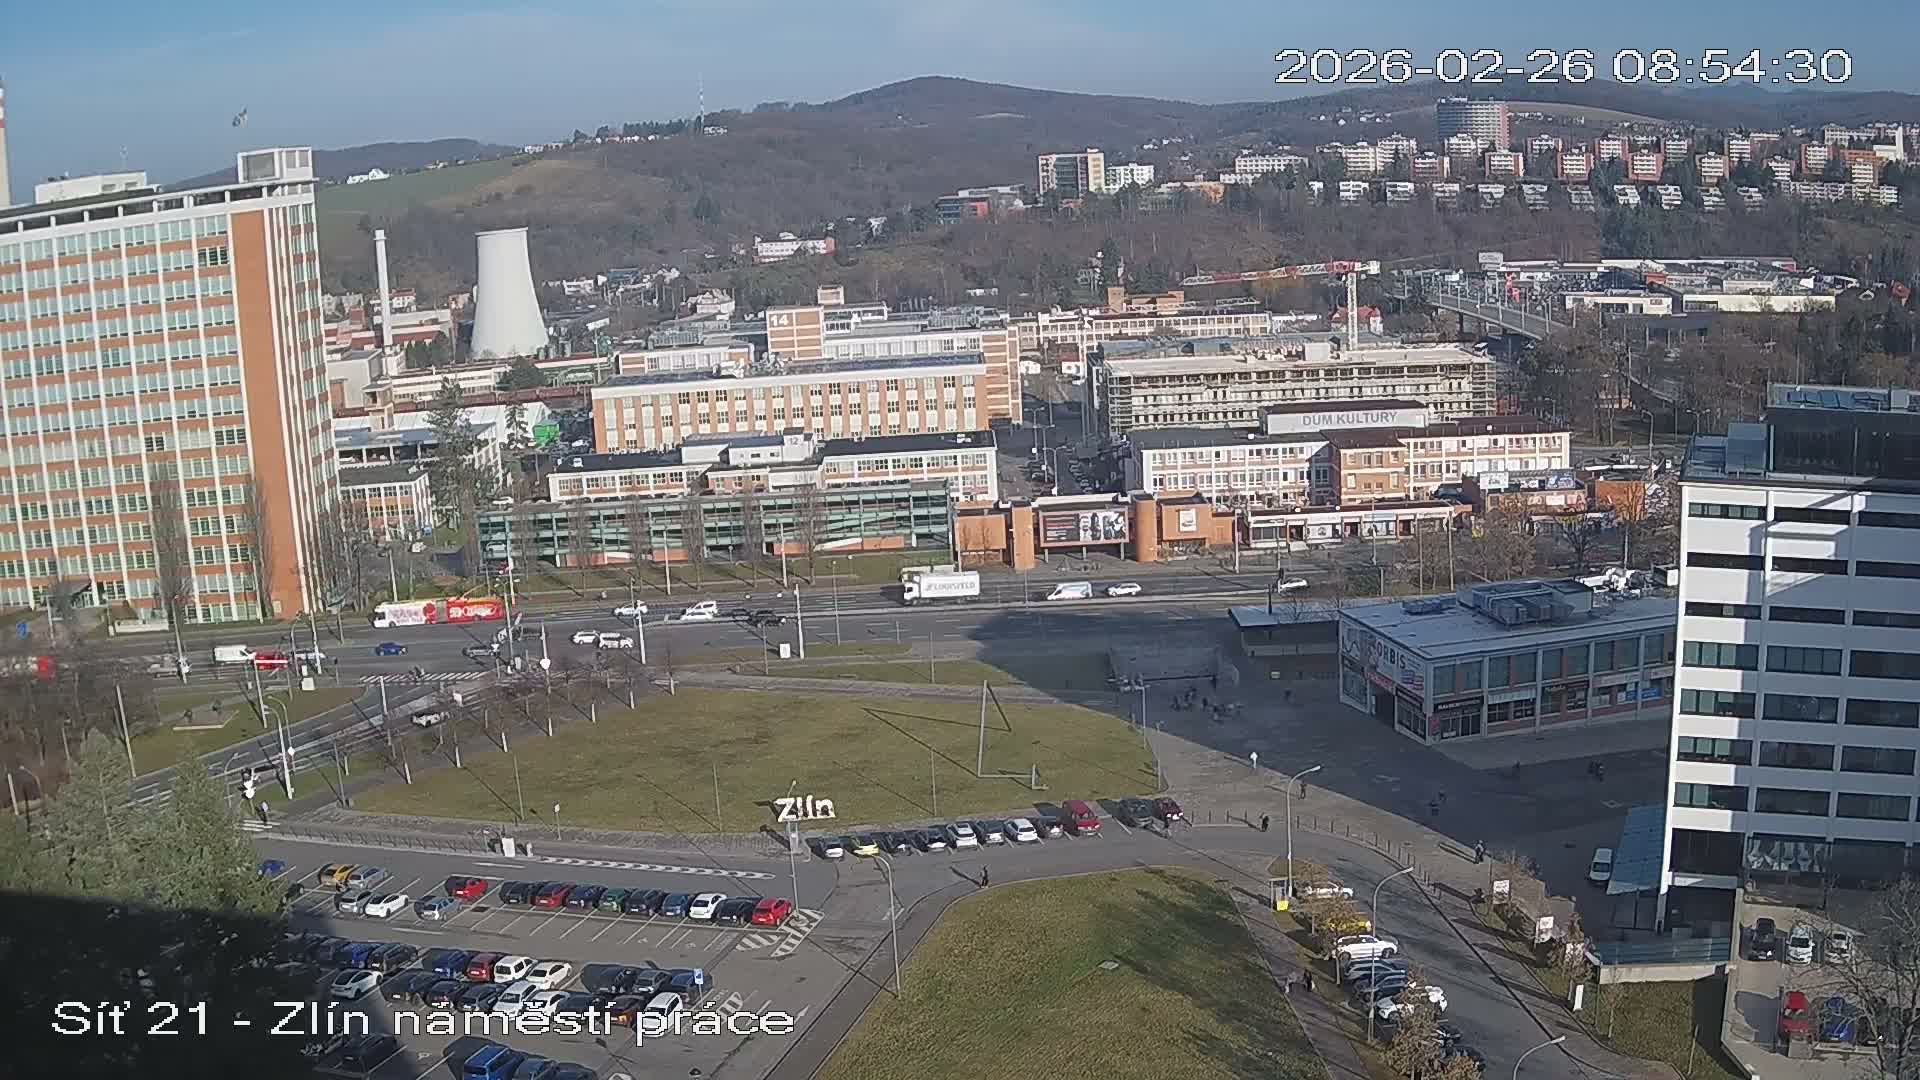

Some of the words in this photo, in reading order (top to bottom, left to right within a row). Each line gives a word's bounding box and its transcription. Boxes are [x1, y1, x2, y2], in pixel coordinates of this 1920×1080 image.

[771, 314, 789, 326] 14
[1336, 411, 1398, 426] KULTURY
[789, 436, 799, 446] 12
[1375, 640, 1407, 670] ORBIS
[773, 794, 836, 822] Zlín
